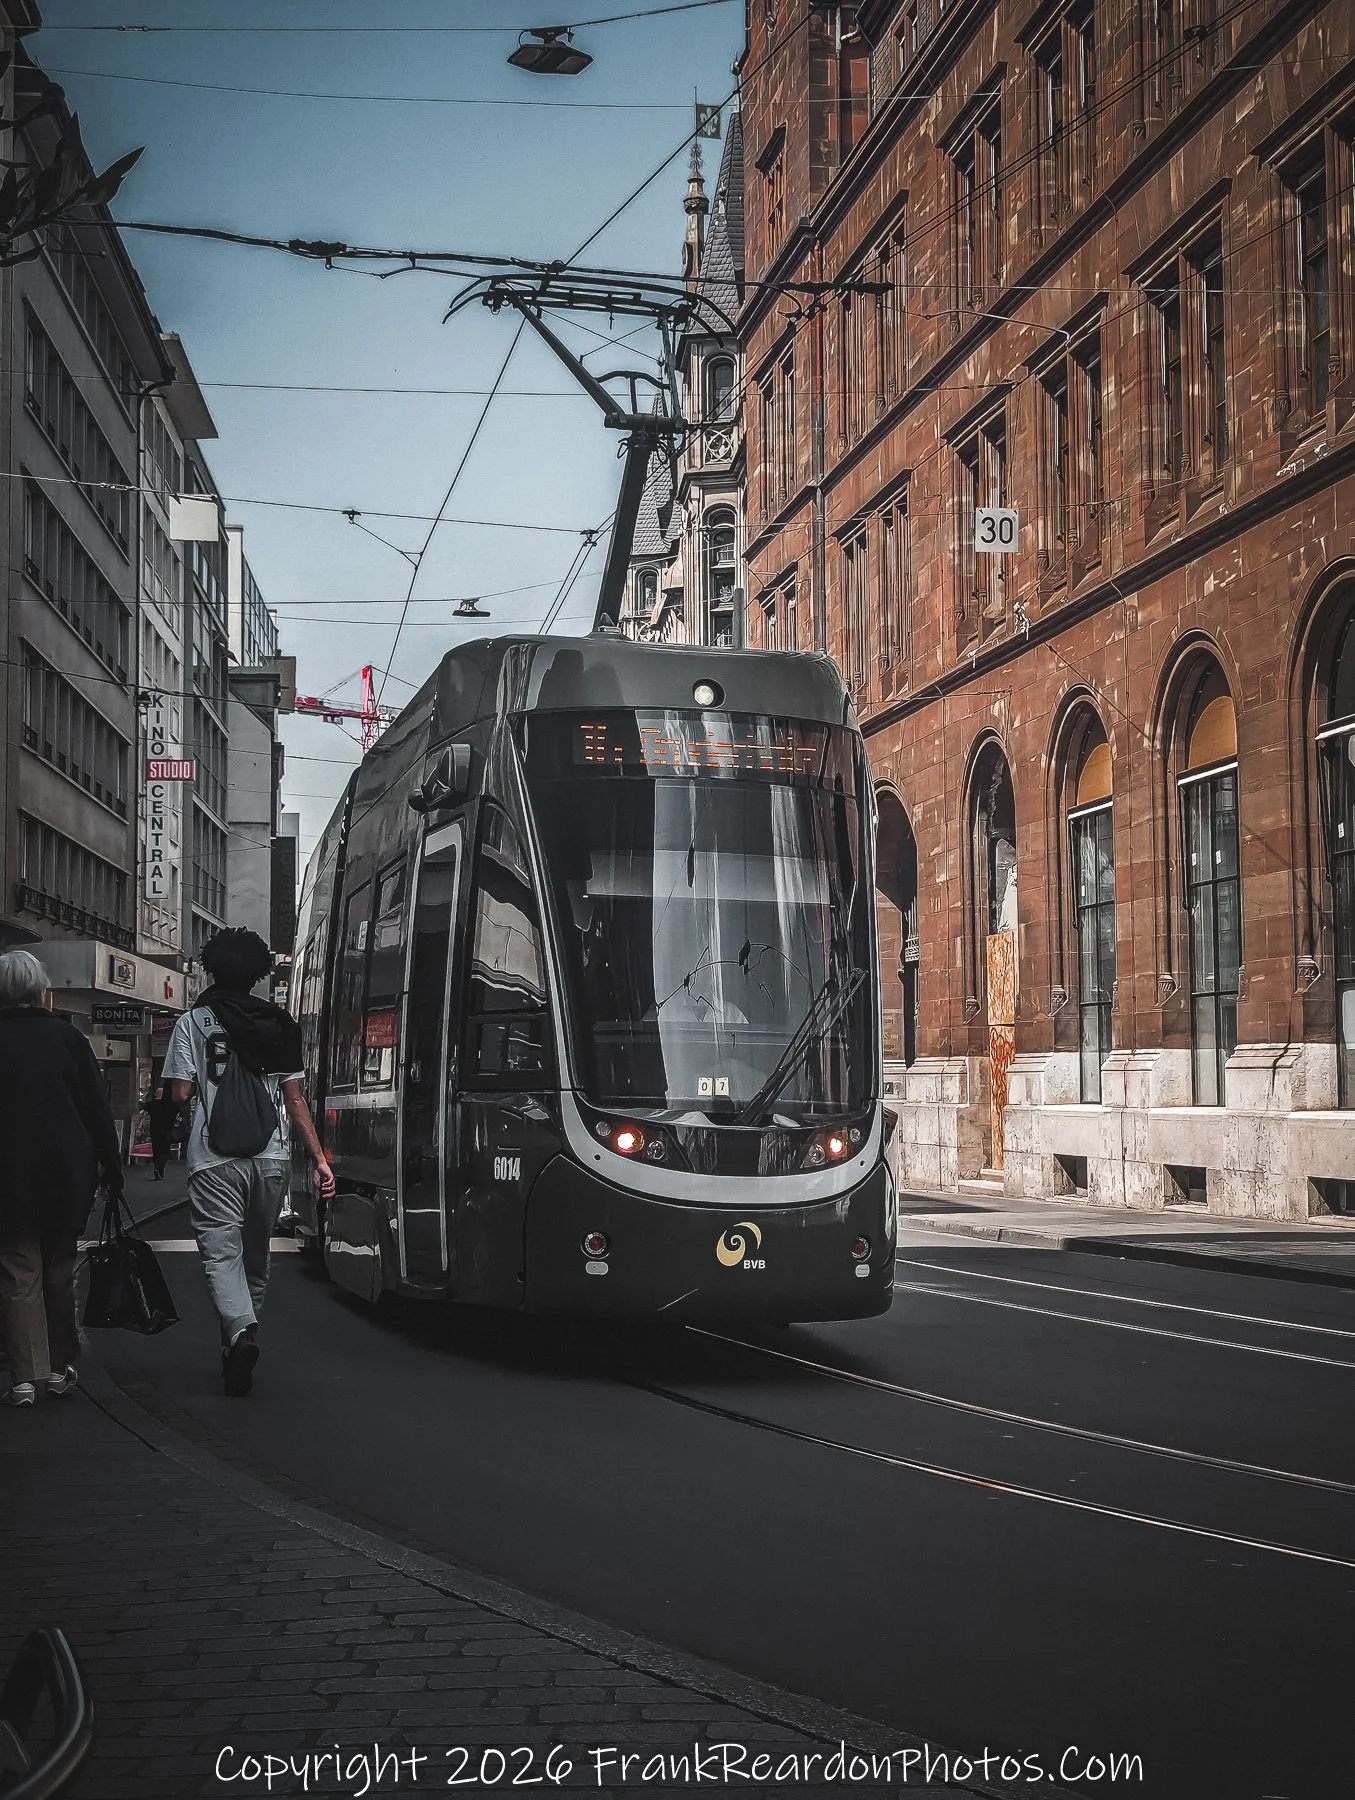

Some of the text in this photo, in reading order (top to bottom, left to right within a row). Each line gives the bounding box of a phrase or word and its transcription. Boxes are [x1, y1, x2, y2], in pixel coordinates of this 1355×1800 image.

[980, 516, 1014, 545] 30
[151, 693, 165, 756] KINO
[150, 760, 191, 780] STUDIO
[151, 784, 165, 895] CENTRAL
[494, 1156, 521, 1181] 6014
[743, 1259, 766, 1270] BVB
